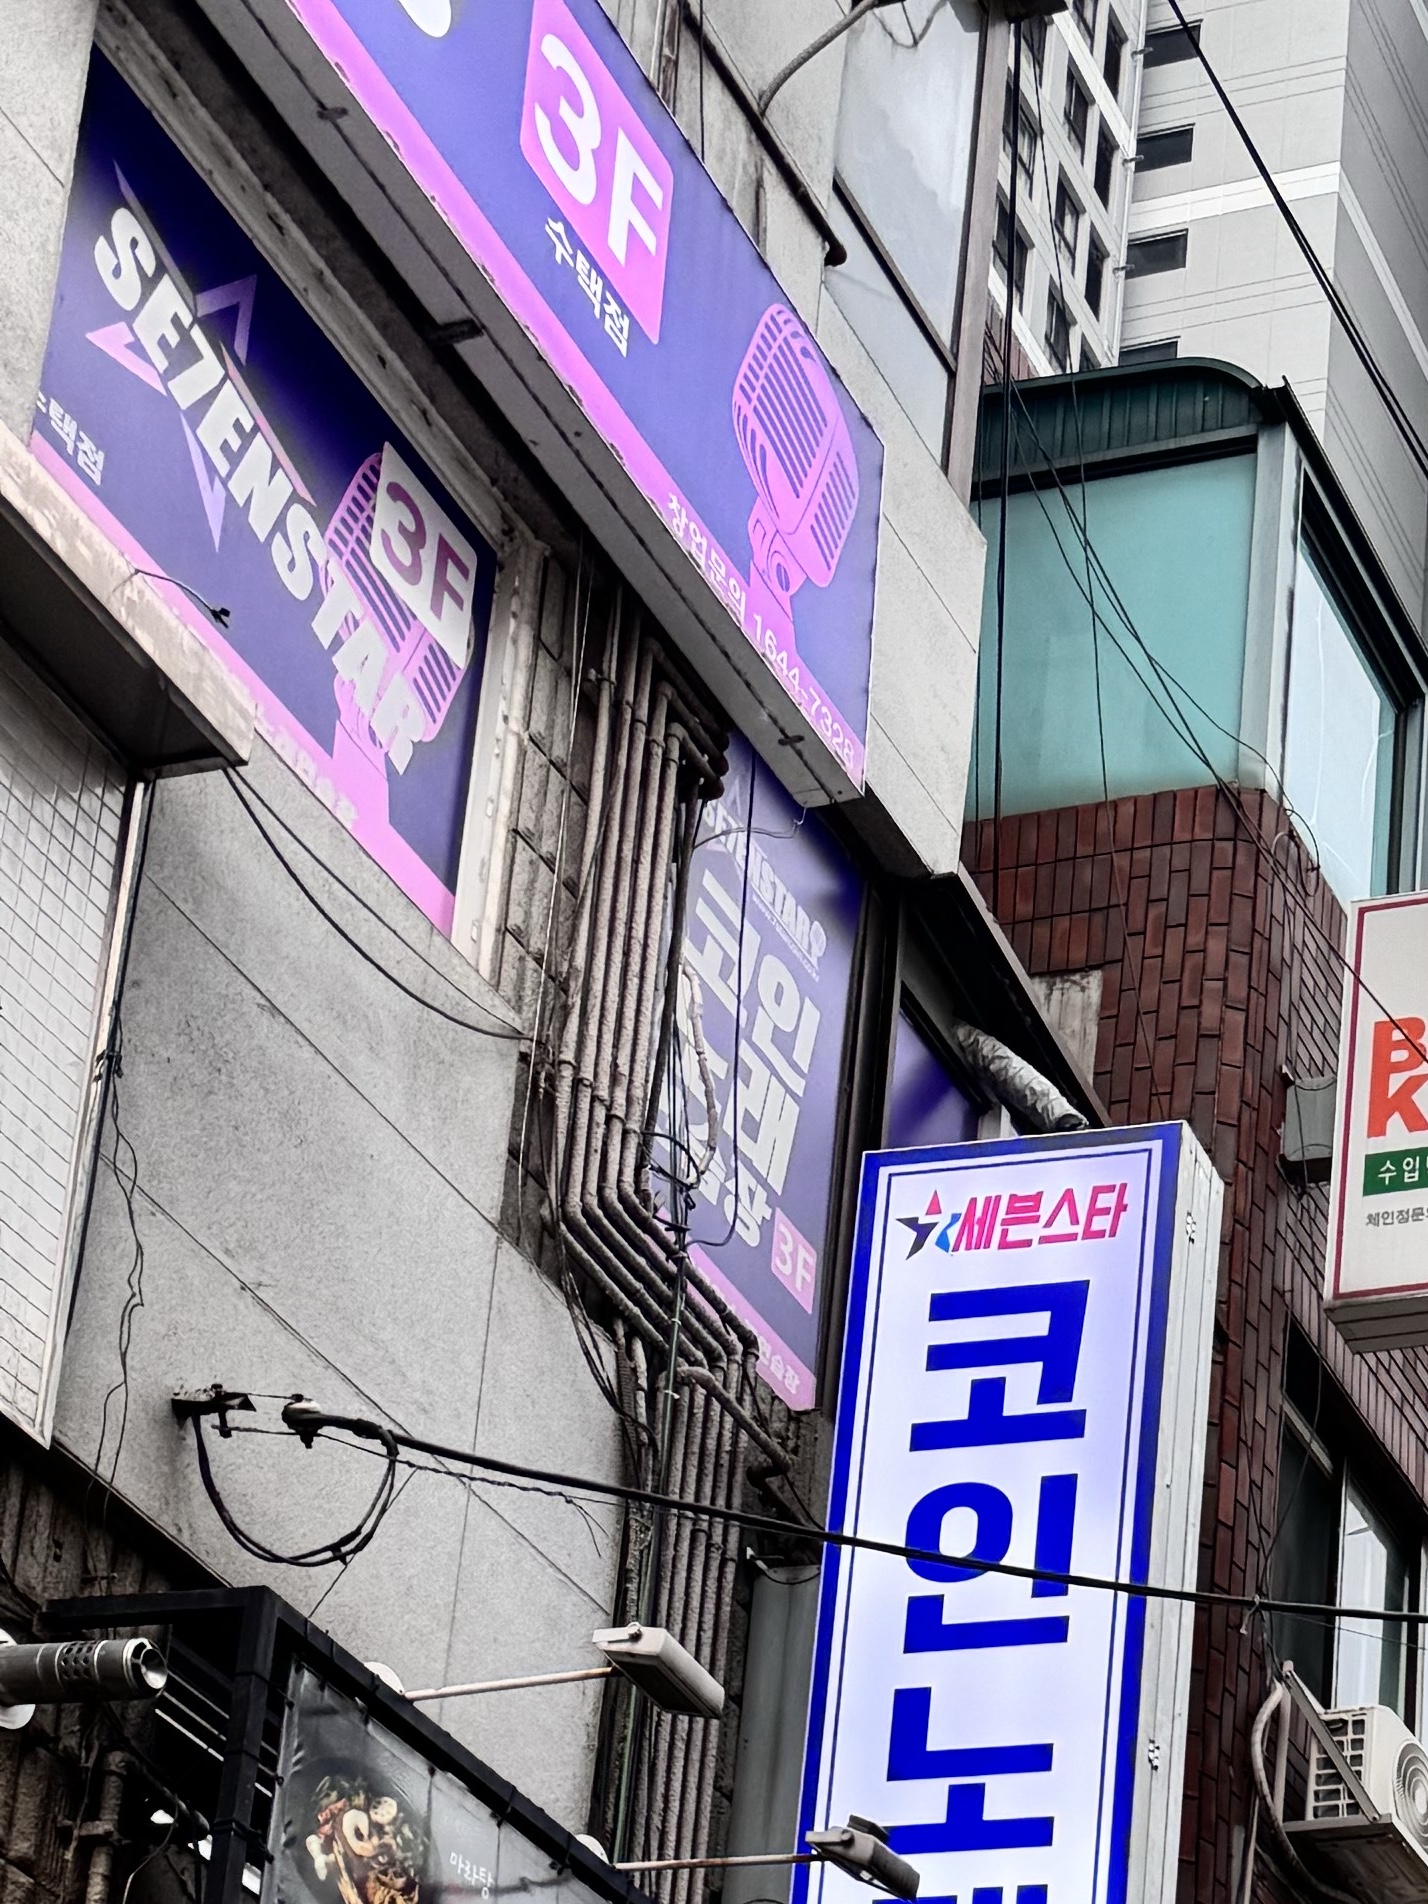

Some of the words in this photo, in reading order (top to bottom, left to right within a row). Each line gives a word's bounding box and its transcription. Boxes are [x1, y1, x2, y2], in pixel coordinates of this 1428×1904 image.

[535, 33, 663, 266] 3F
[545, 219, 629, 357] 수택점
[38, 392, 104, 485] 택점
[381, 481, 470, 620] 3F
[666, 492, 746, 625] 창업문의
[752, 609, 856, 770] 1644-7328
[776, 1222, 816, 1287] 3F
[953, 1184, 1127, 1252] 세븐스타
